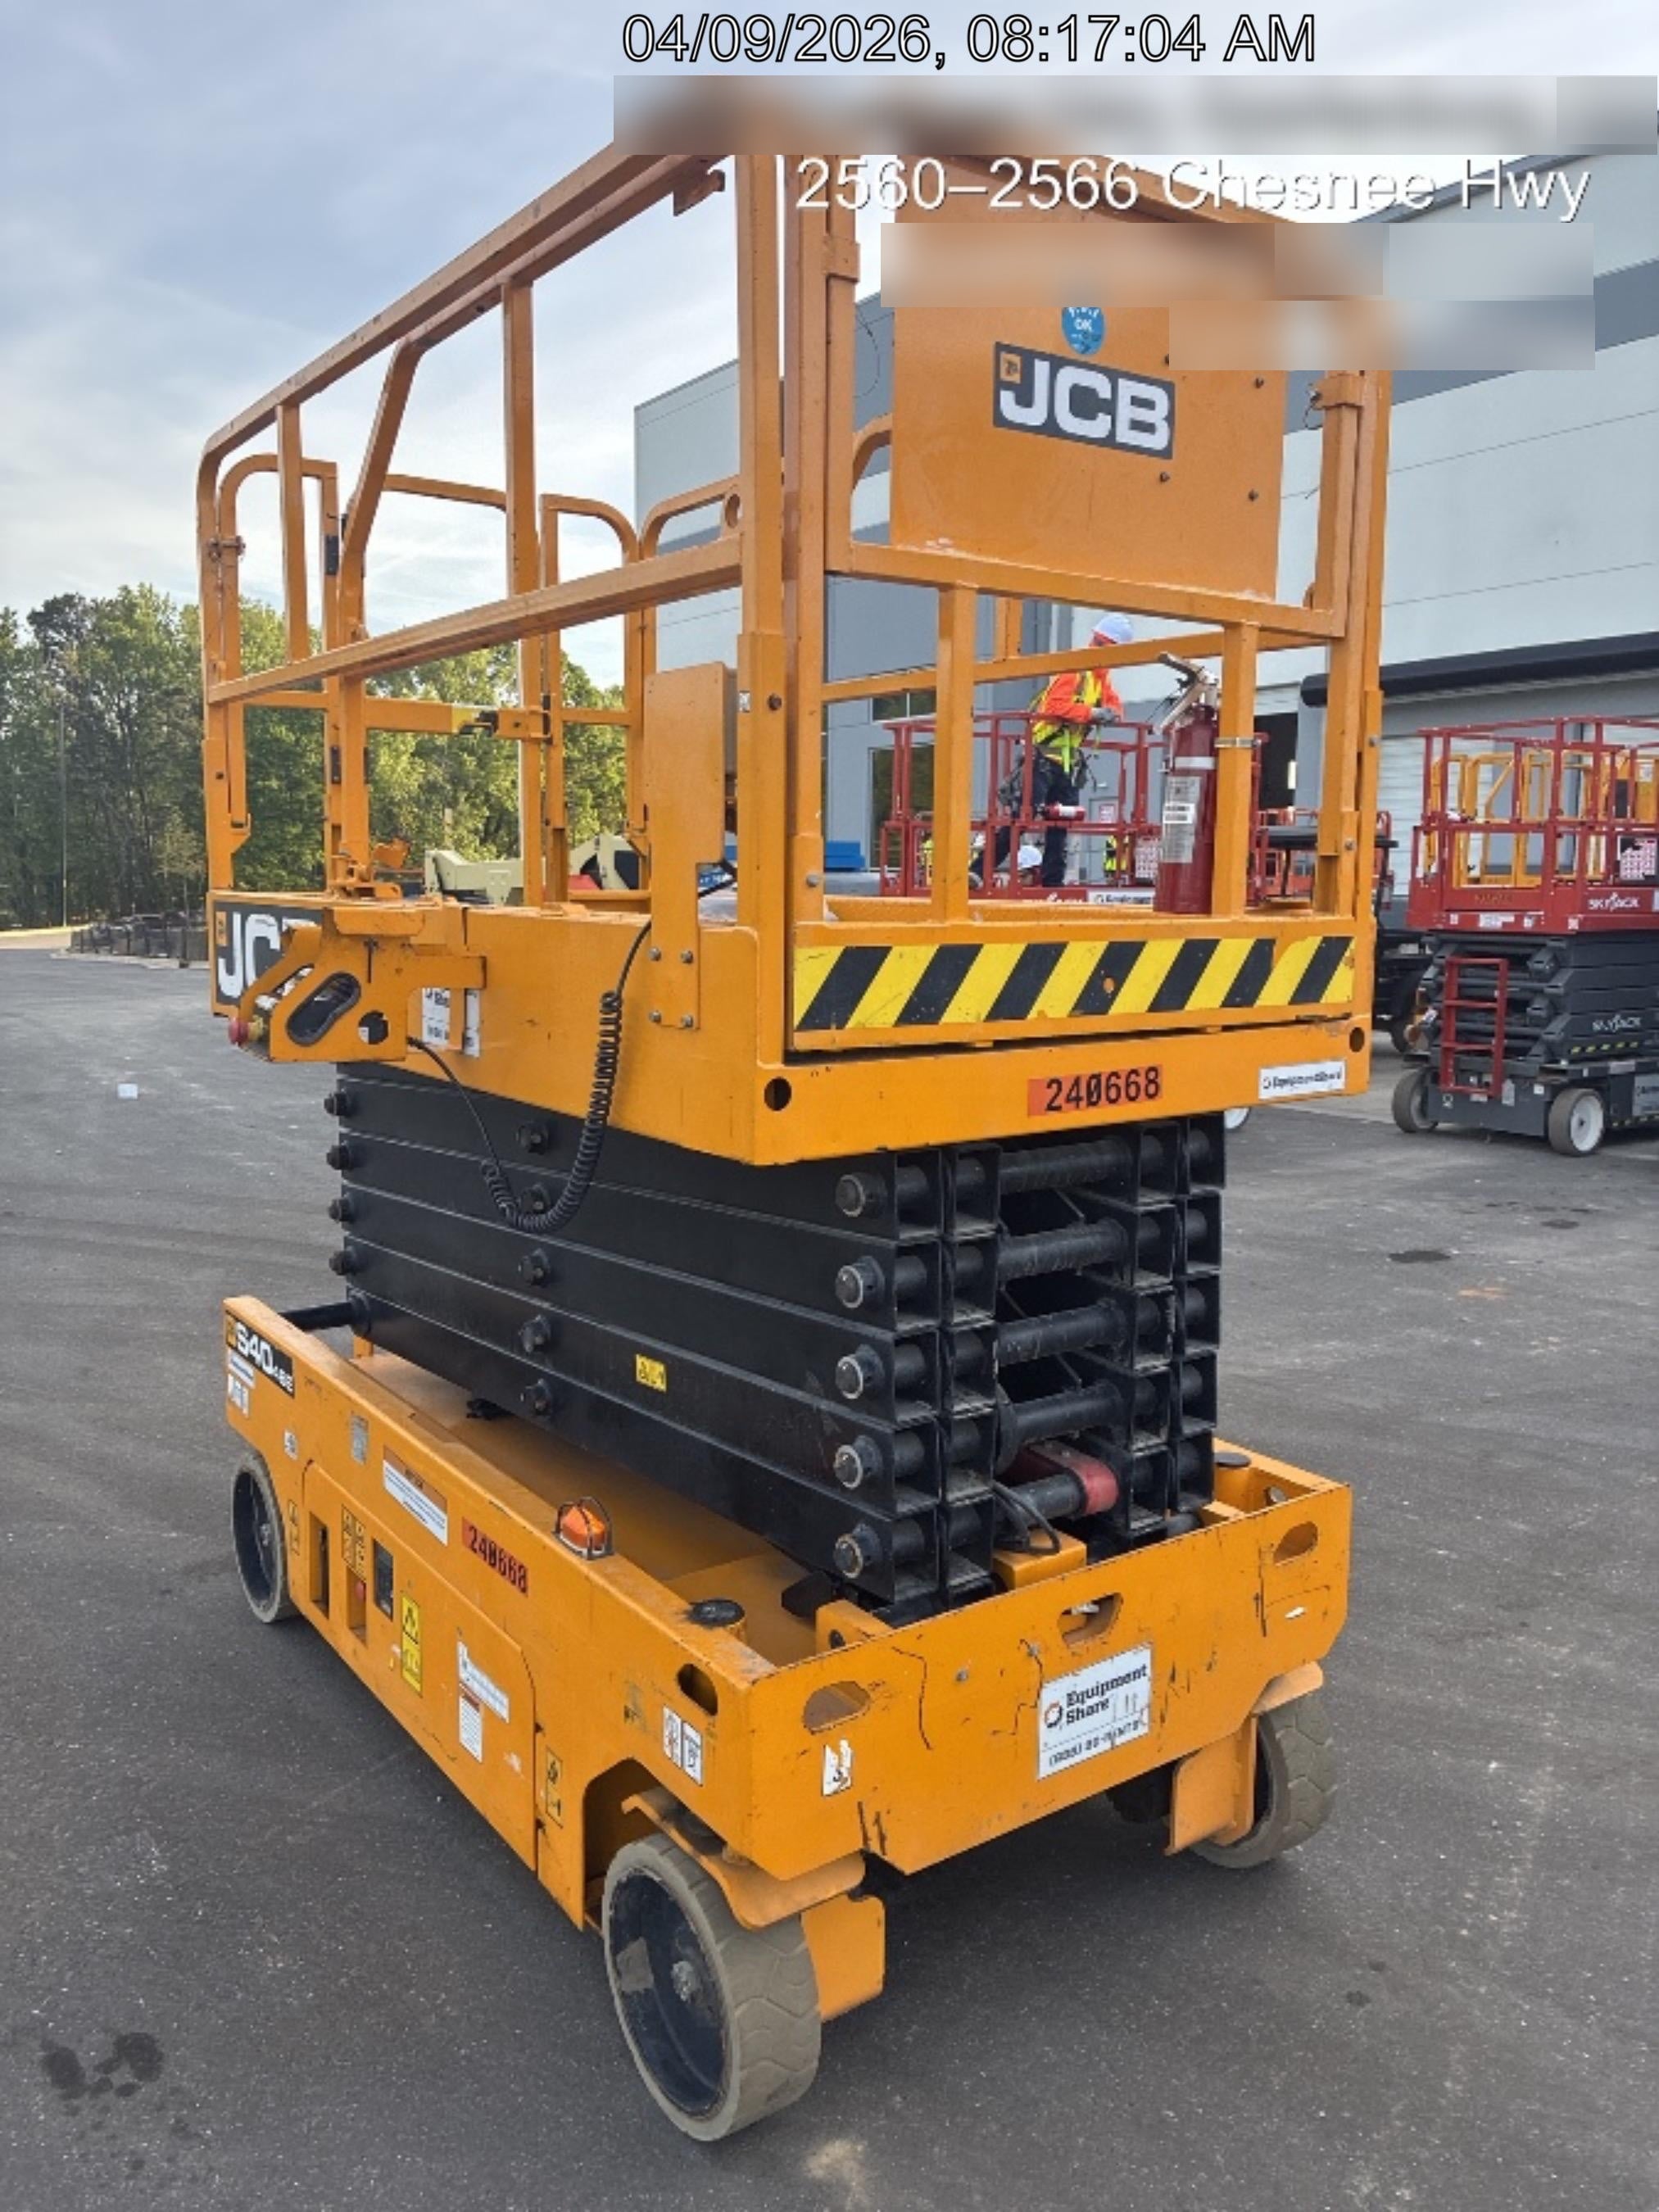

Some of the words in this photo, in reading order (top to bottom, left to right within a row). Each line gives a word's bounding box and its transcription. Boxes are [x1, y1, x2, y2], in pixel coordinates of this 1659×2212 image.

[999, 358, 1171, 451] JCB
[1045, 1066, 1160, 1112] 240668
[469, 1525, 527, 1593] 240668
[1065, 1663, 1148, 1708] Equipment
[1065, 1697, 1110, 1725] Share
